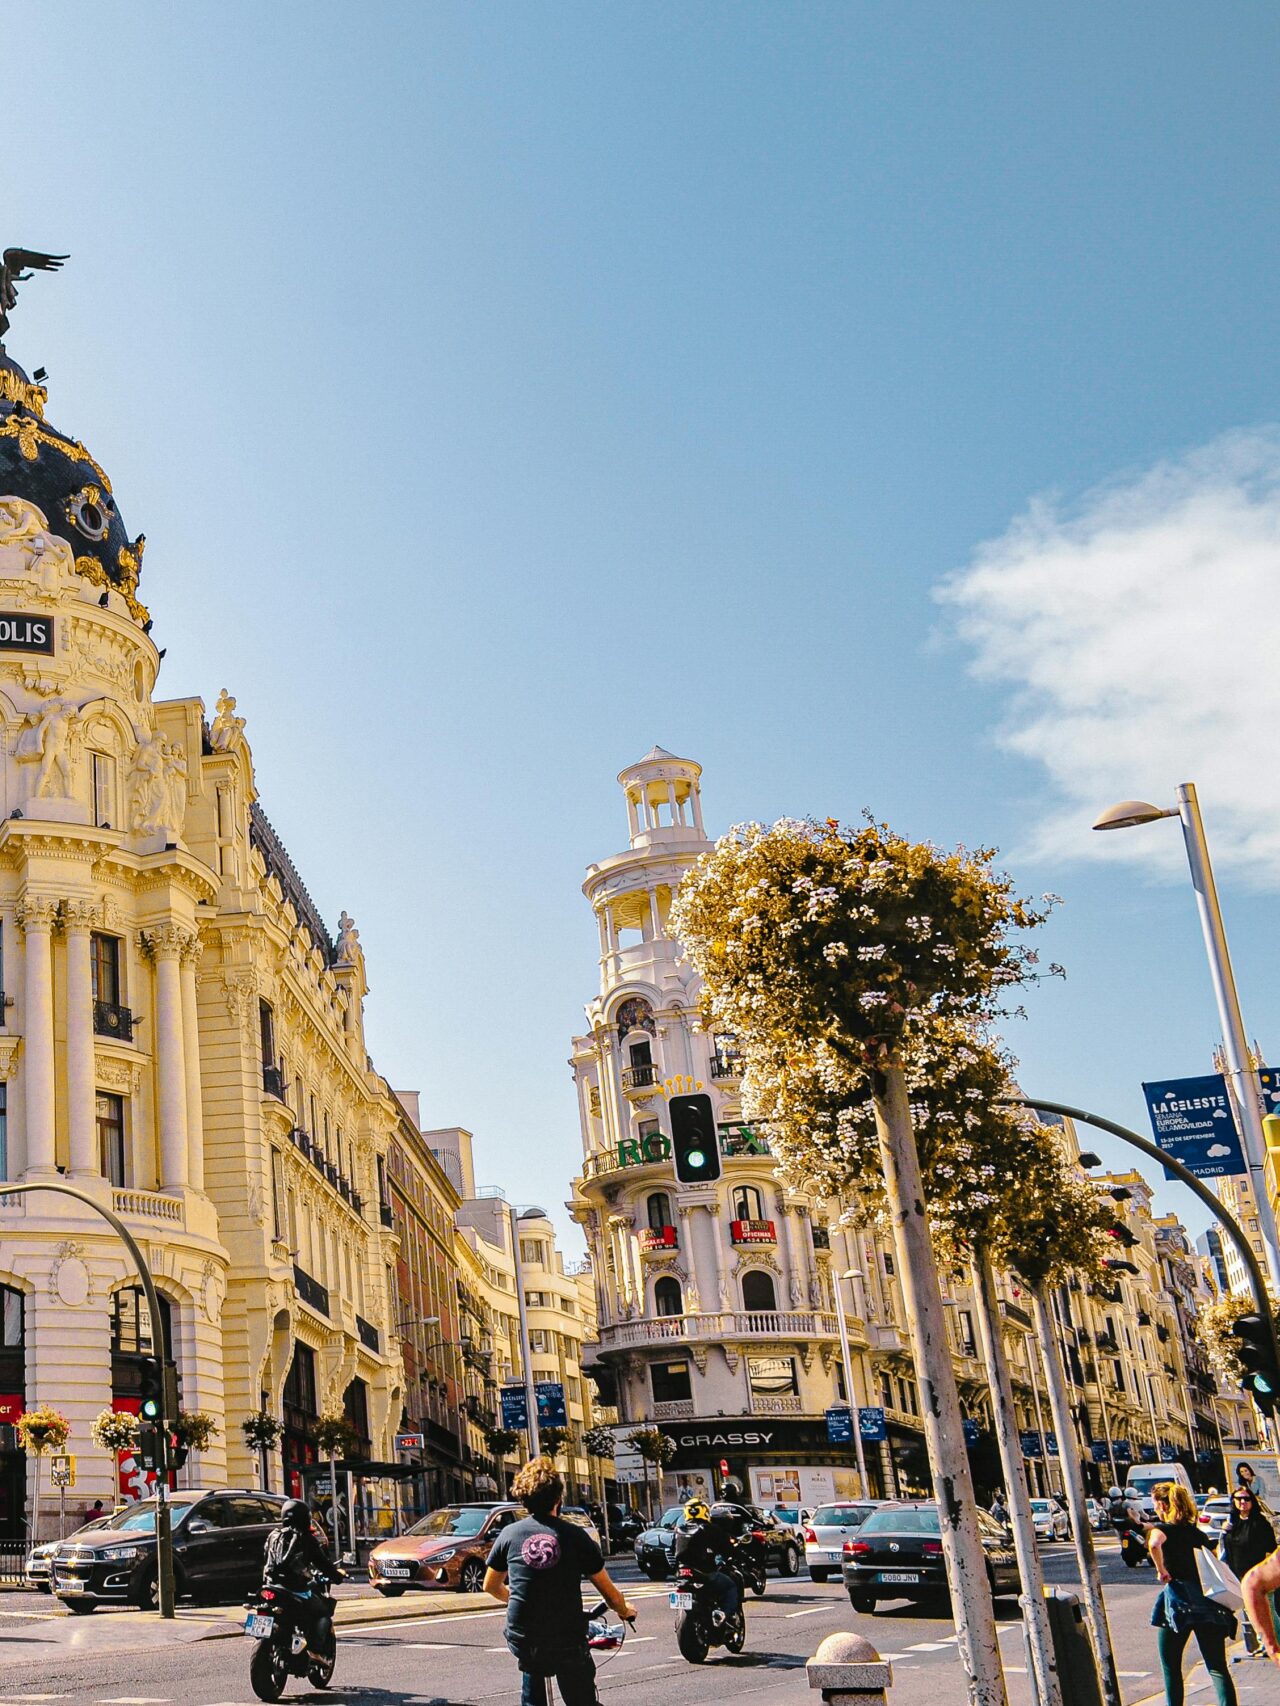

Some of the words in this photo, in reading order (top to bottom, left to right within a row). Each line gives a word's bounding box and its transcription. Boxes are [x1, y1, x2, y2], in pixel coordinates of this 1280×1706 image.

[1152, 1102, 1169, 1114] LA
[1170, 1095, 1226, 1112] CELESTE
[1155, 1111, 1183, 1121] SEMANA
[1156, 1117, 1189, 1127] EUROPEA
[1183, 1132, 1216, 1141] SEPTIEMBRE
[615, 1127, 766, 1167] ROEX
[1193, 1166, 1225, 1175] MADRID
[680, 1432, 773, 1447] GRASSY
